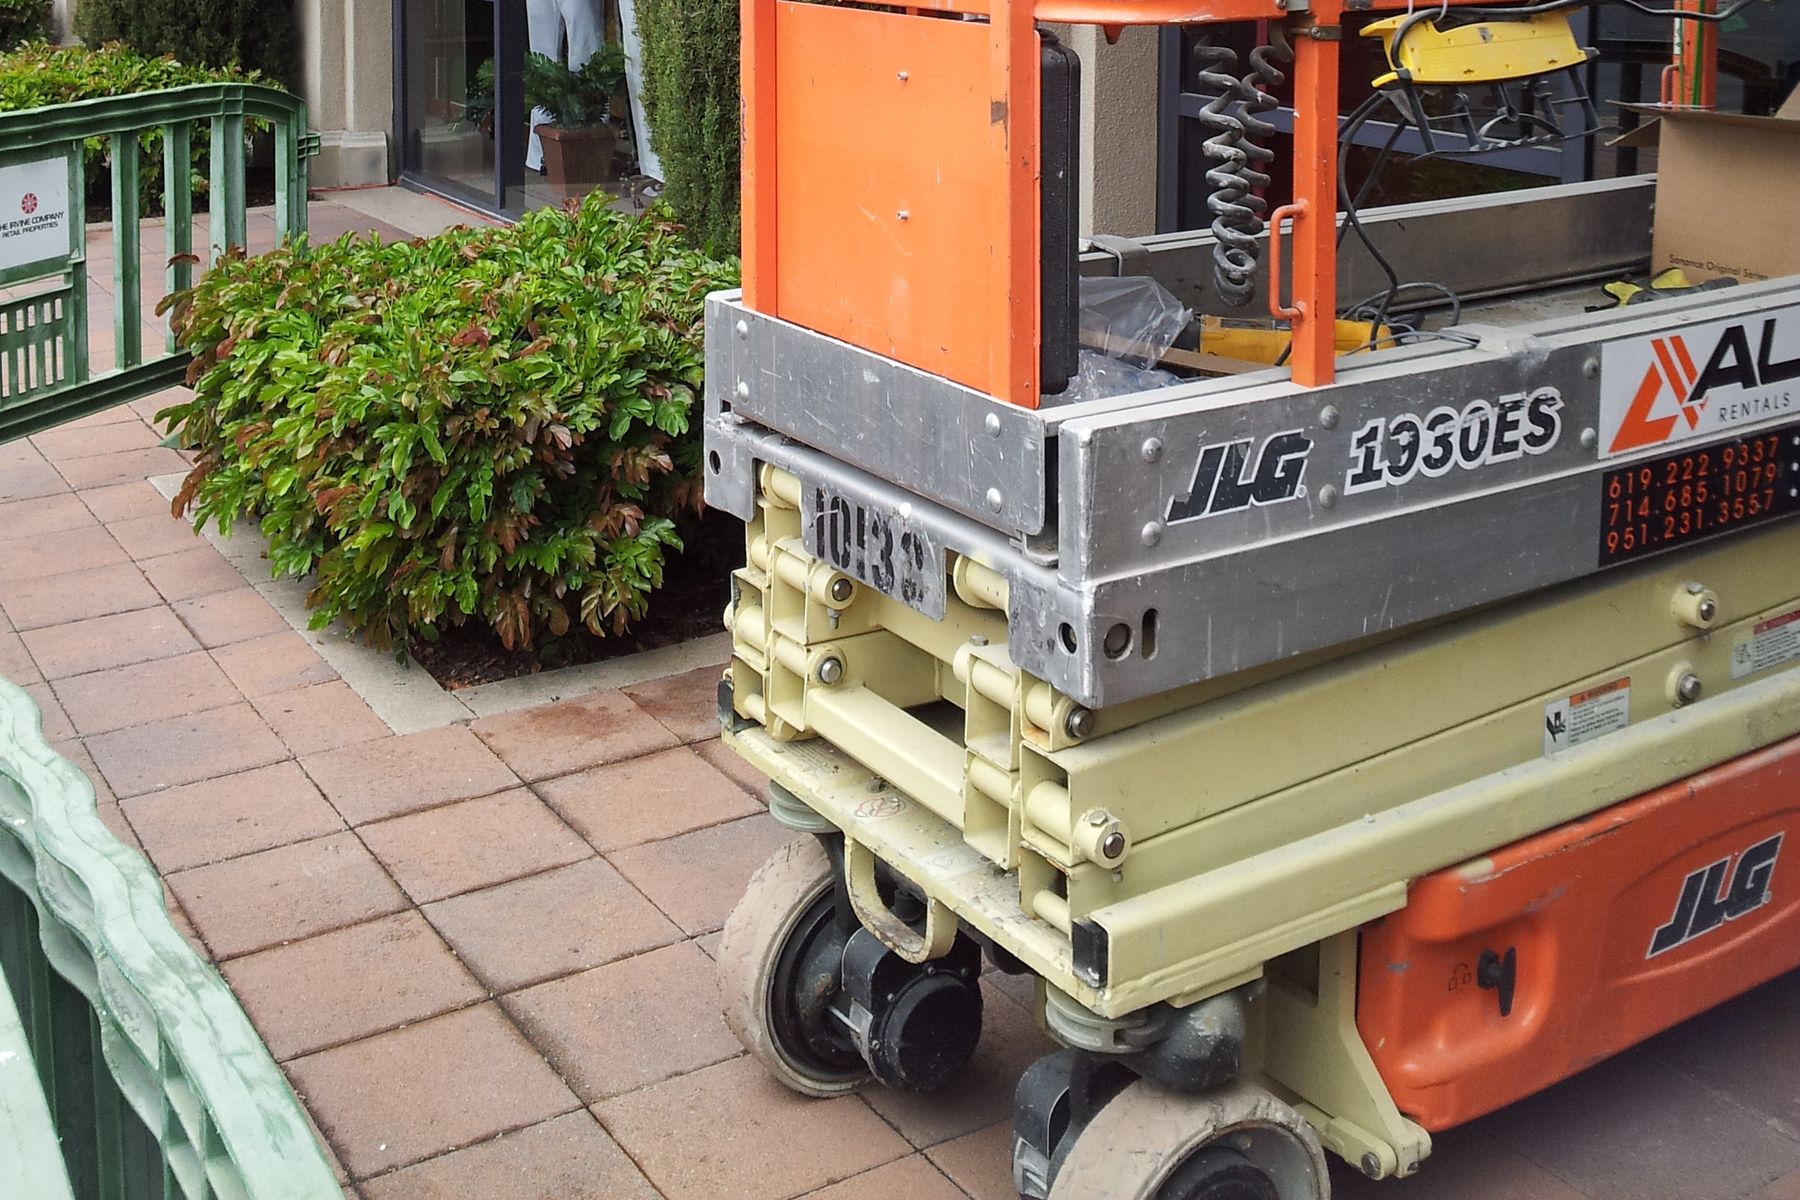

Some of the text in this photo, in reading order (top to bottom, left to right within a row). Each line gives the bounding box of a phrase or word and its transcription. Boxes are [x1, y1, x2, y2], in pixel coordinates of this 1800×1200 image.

[22, 221, 59, 233] PROPERTIES
[31, 211, 64, 224] COMPANY
[1719, 392, 1791, 423] RENTALS
[1166, 386, 1566, 526] JLG 1930ES
[1609, 436, 1779, 499] 619.222.9337
[1606, 489, 1775, 555] 951.231.3557
[1608, 462, 1777, 527] 714.685.1079
[1644, 830, 1786, 961] JLG
